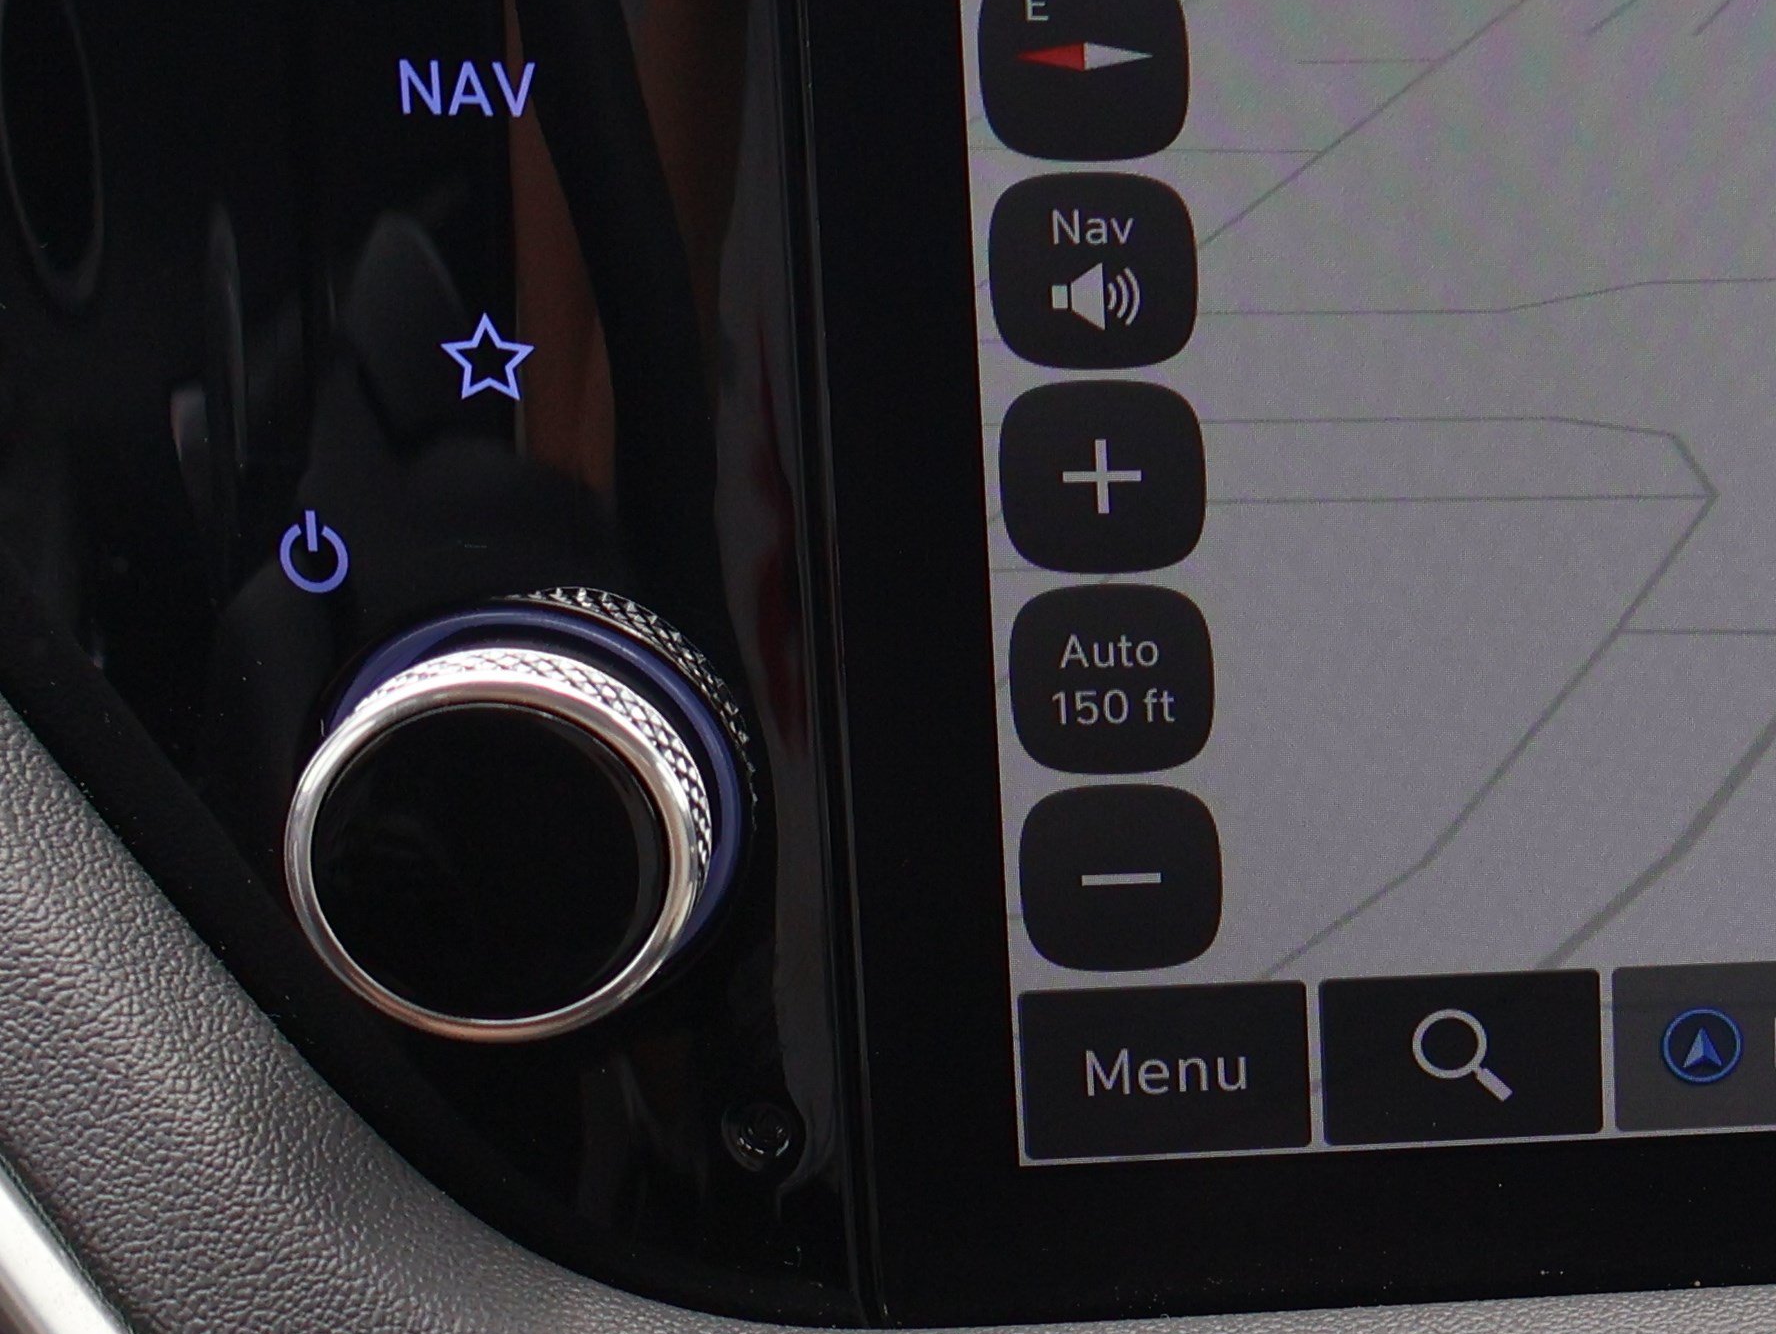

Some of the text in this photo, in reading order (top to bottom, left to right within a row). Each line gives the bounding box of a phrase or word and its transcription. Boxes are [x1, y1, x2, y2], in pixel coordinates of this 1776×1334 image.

[399, 59, 536, 116] NAV
[1052, 209, 1134, 245] Nav
[1060, 634, 1159, 669] Auto
[1052, 687, 1175, 725] 150 ft
[1085, 1048, 1247, 1097] Menu
